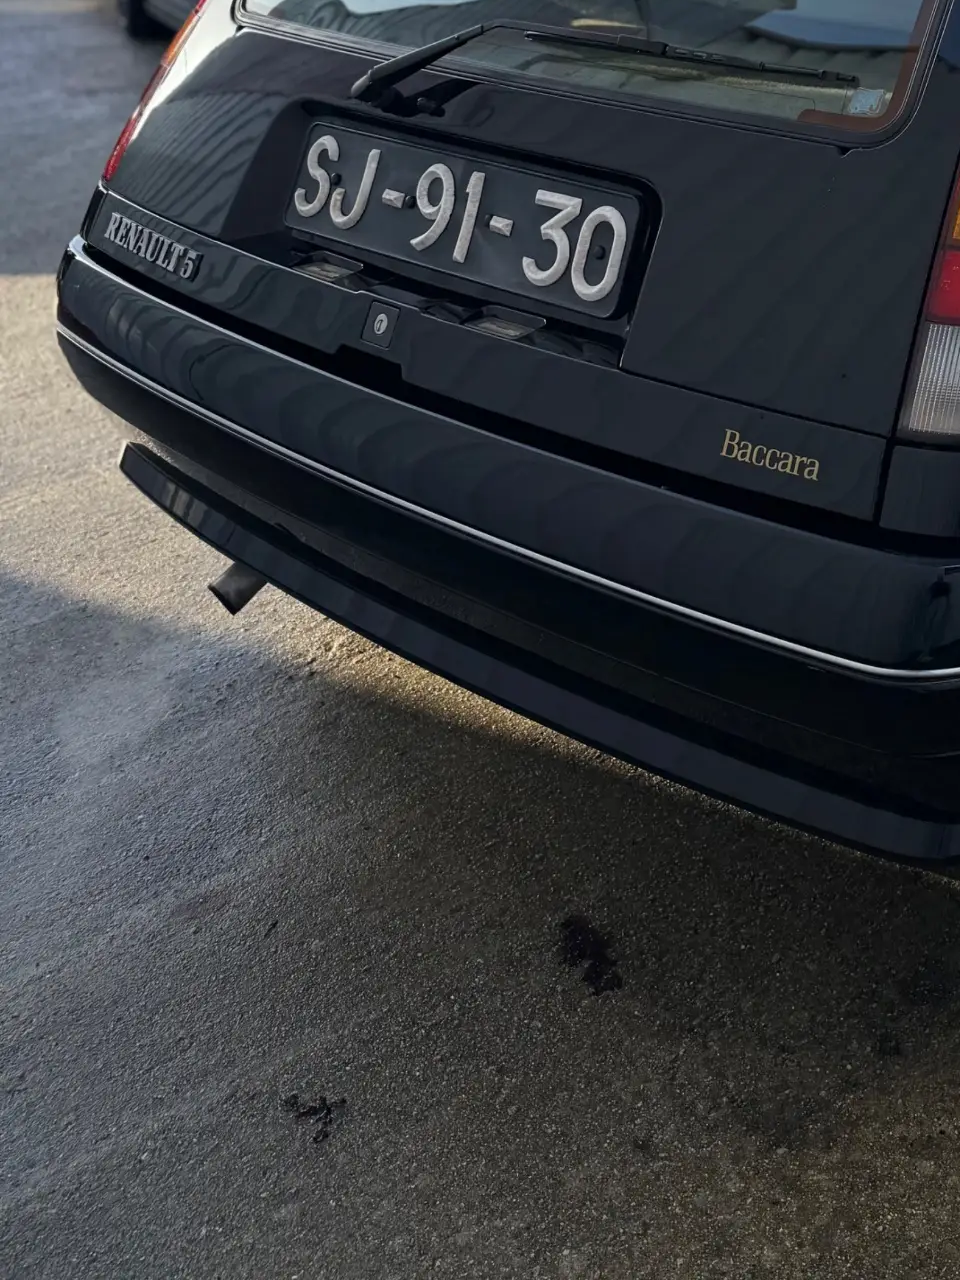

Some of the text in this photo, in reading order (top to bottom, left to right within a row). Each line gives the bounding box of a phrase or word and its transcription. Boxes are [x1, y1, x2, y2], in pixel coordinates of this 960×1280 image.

[104, 211, 201, 279] RENAULT 5
[294, 134, 628, 302] SJ-91-30
[720, 428, 820, 482] Baccara
